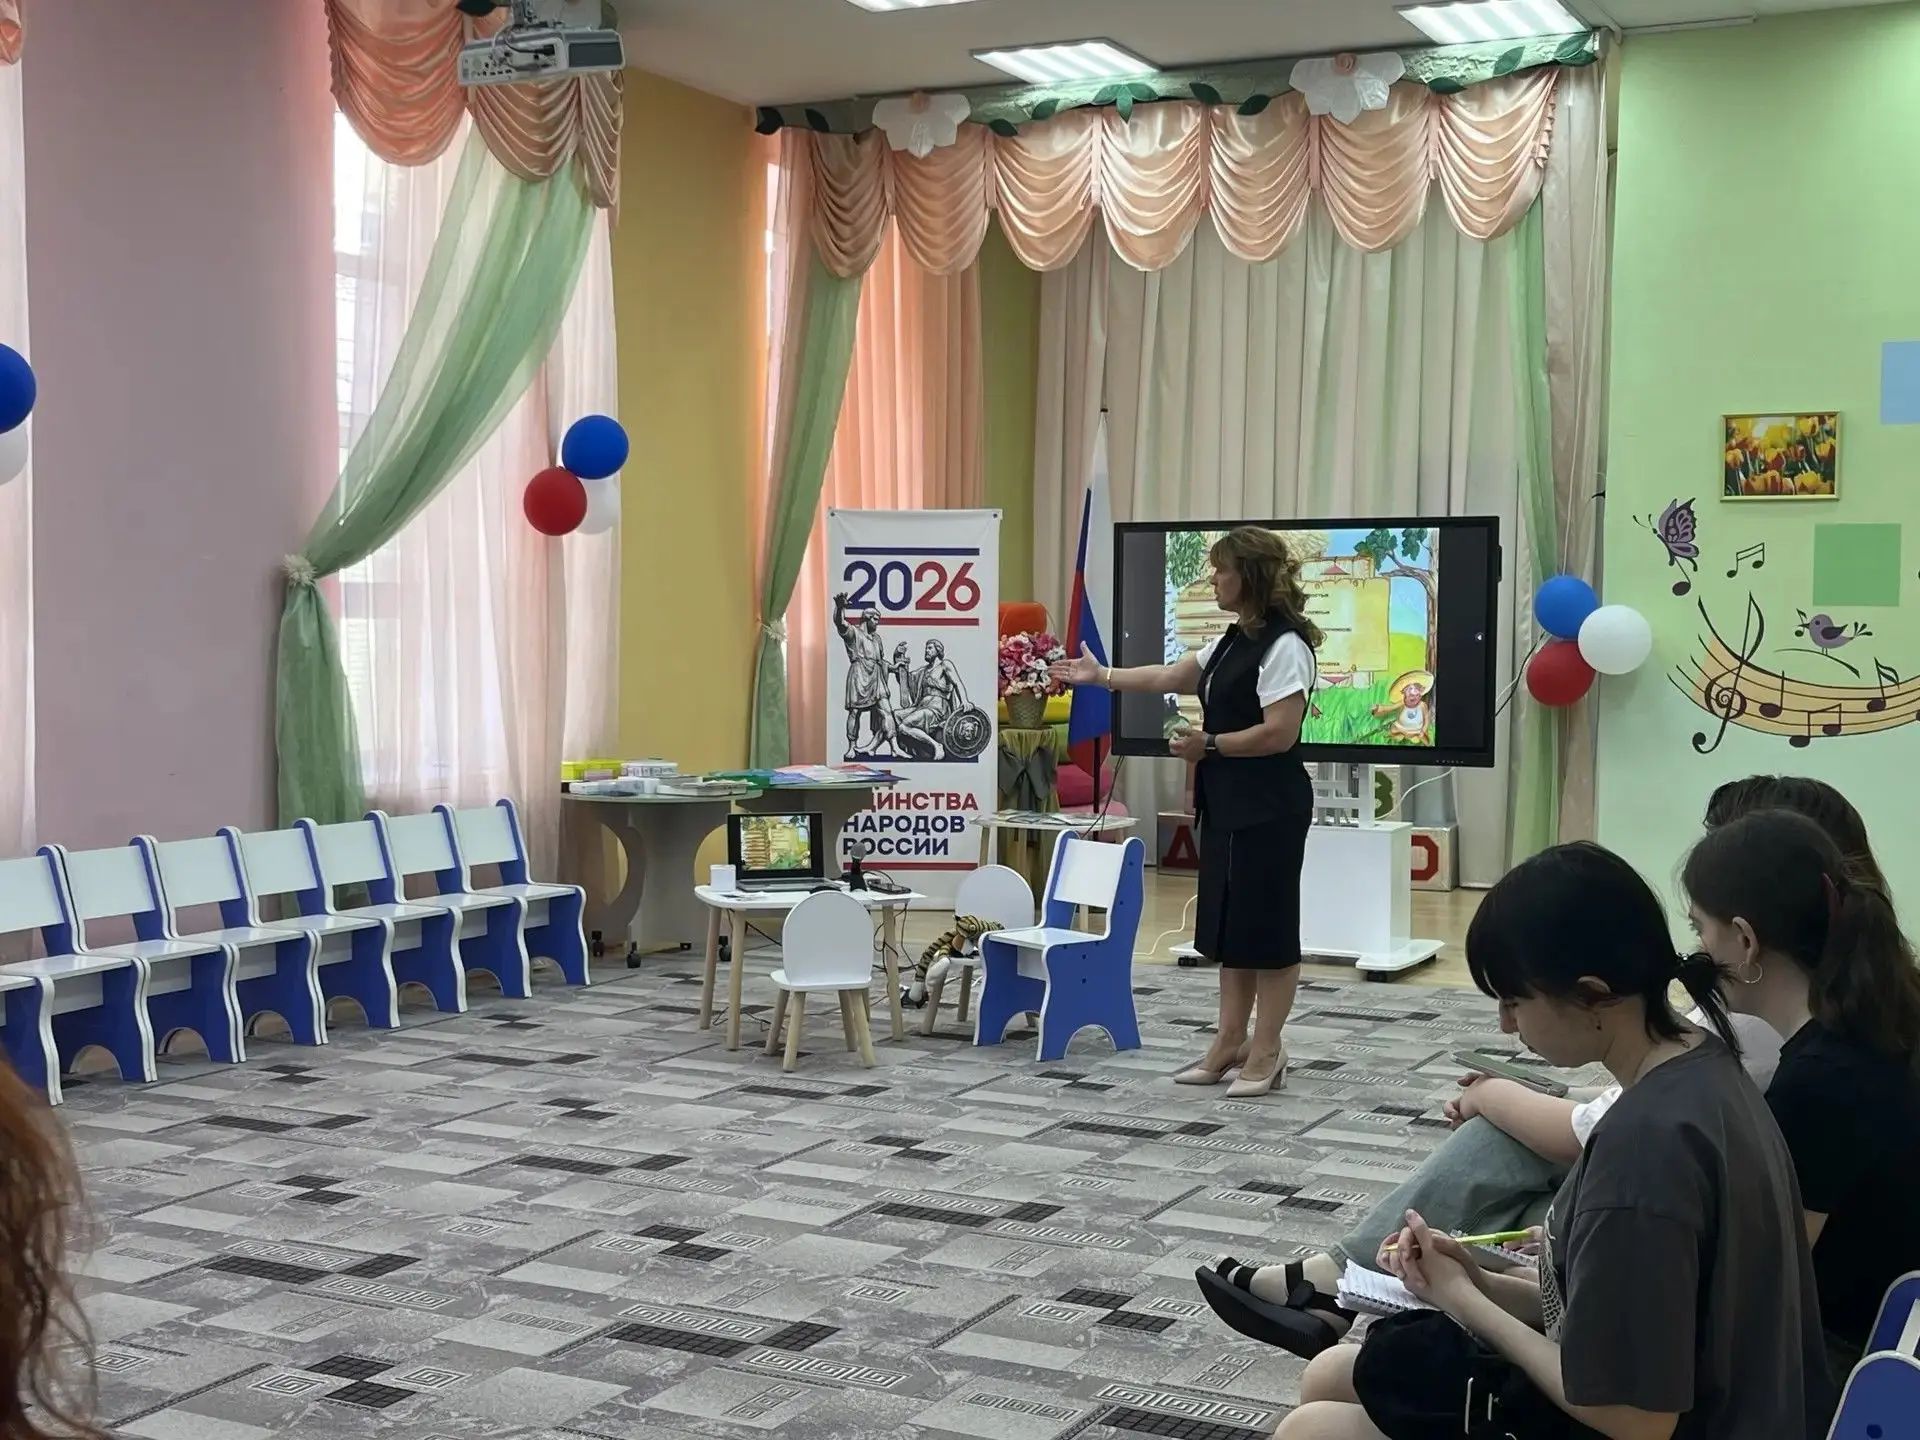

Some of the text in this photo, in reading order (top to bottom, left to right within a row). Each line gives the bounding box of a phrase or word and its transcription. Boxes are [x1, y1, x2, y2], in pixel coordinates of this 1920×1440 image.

[843, 560, 981, 611] 2026
[861, 792, 979, 813] ИНСТВА
[843, 815, 966, 836] НАРОДОВ
[843, 838, 949, 855] РОССИИ
